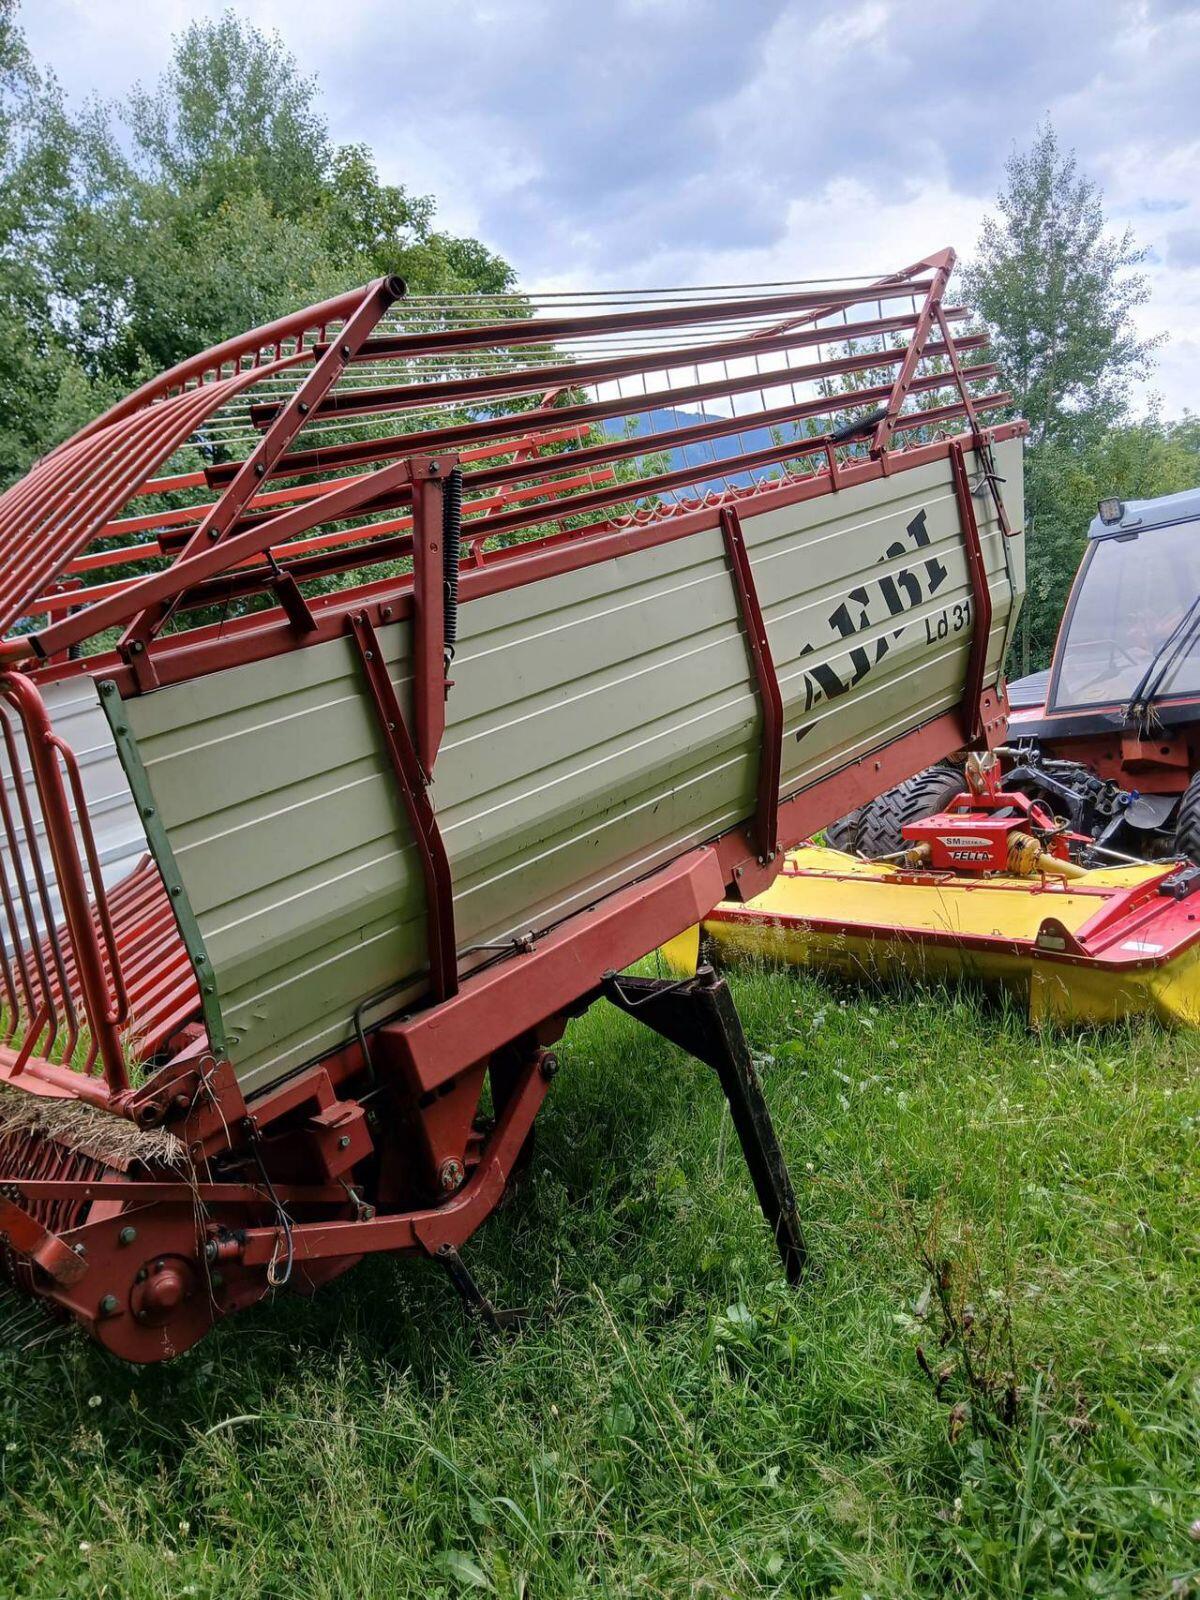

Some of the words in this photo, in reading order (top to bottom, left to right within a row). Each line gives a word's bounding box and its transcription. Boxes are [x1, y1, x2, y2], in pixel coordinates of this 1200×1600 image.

[925, 611, 949, 646] Ld
[952, 601, 971, 632] 31
[953, 852, 989, 860] FELLA
